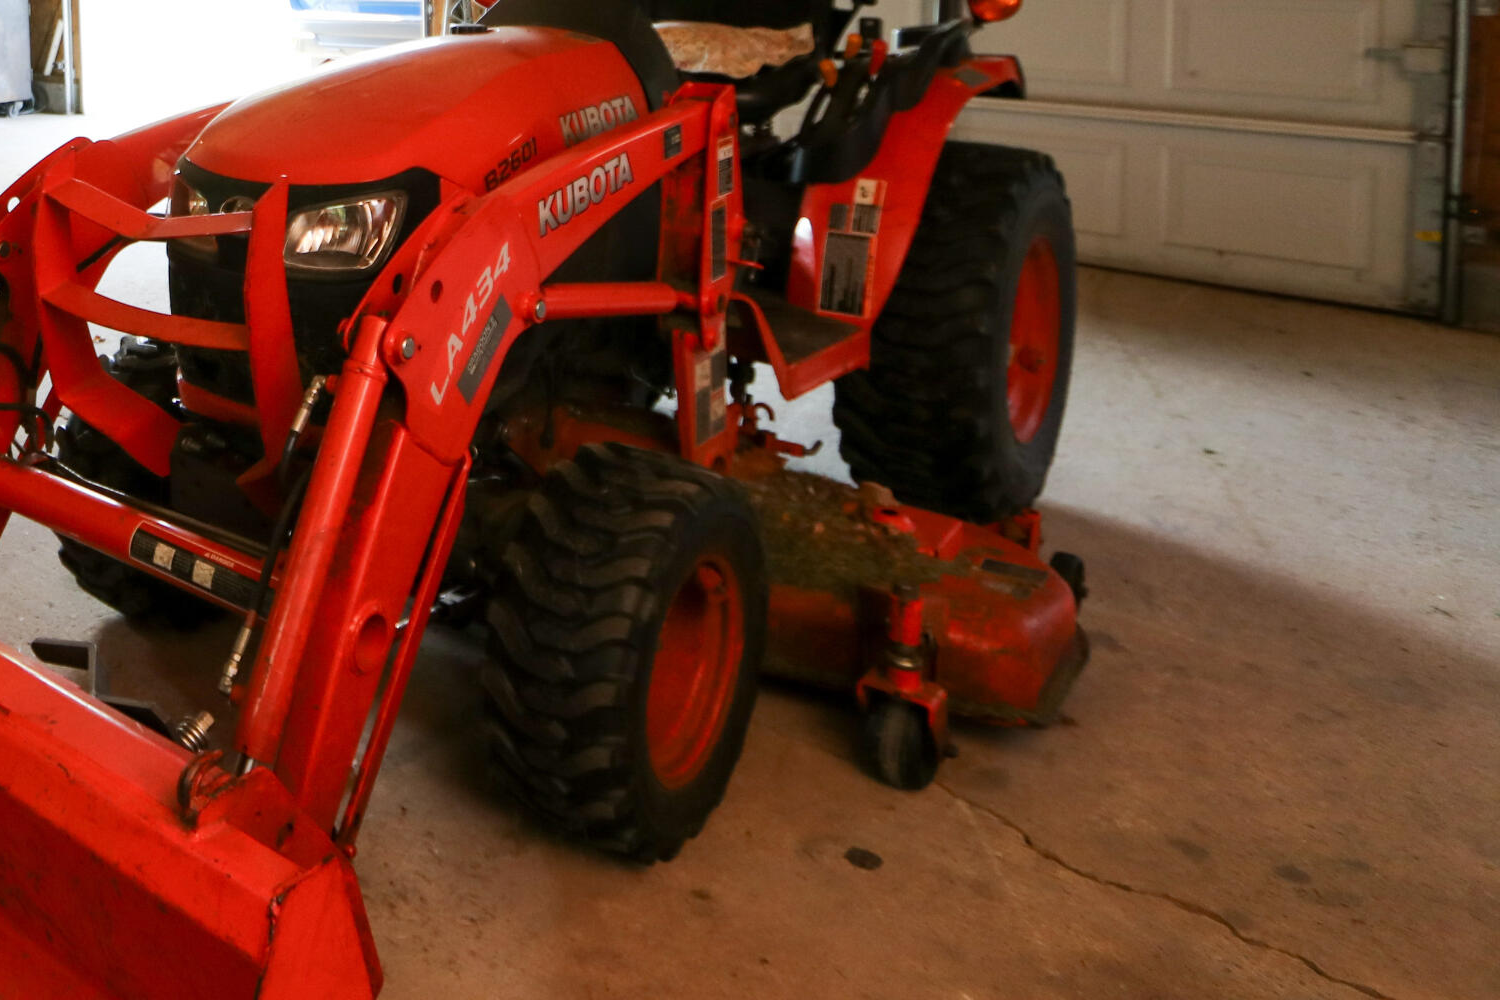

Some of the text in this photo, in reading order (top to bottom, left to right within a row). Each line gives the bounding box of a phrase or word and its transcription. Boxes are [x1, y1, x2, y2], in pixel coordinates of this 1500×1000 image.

[560, 96, 639, 148] KUBOTA
[484, 137, 537, 192] B2601
[538, 152, 634, 237] KUBOTA
[430, 242, 511, 406] LA434
